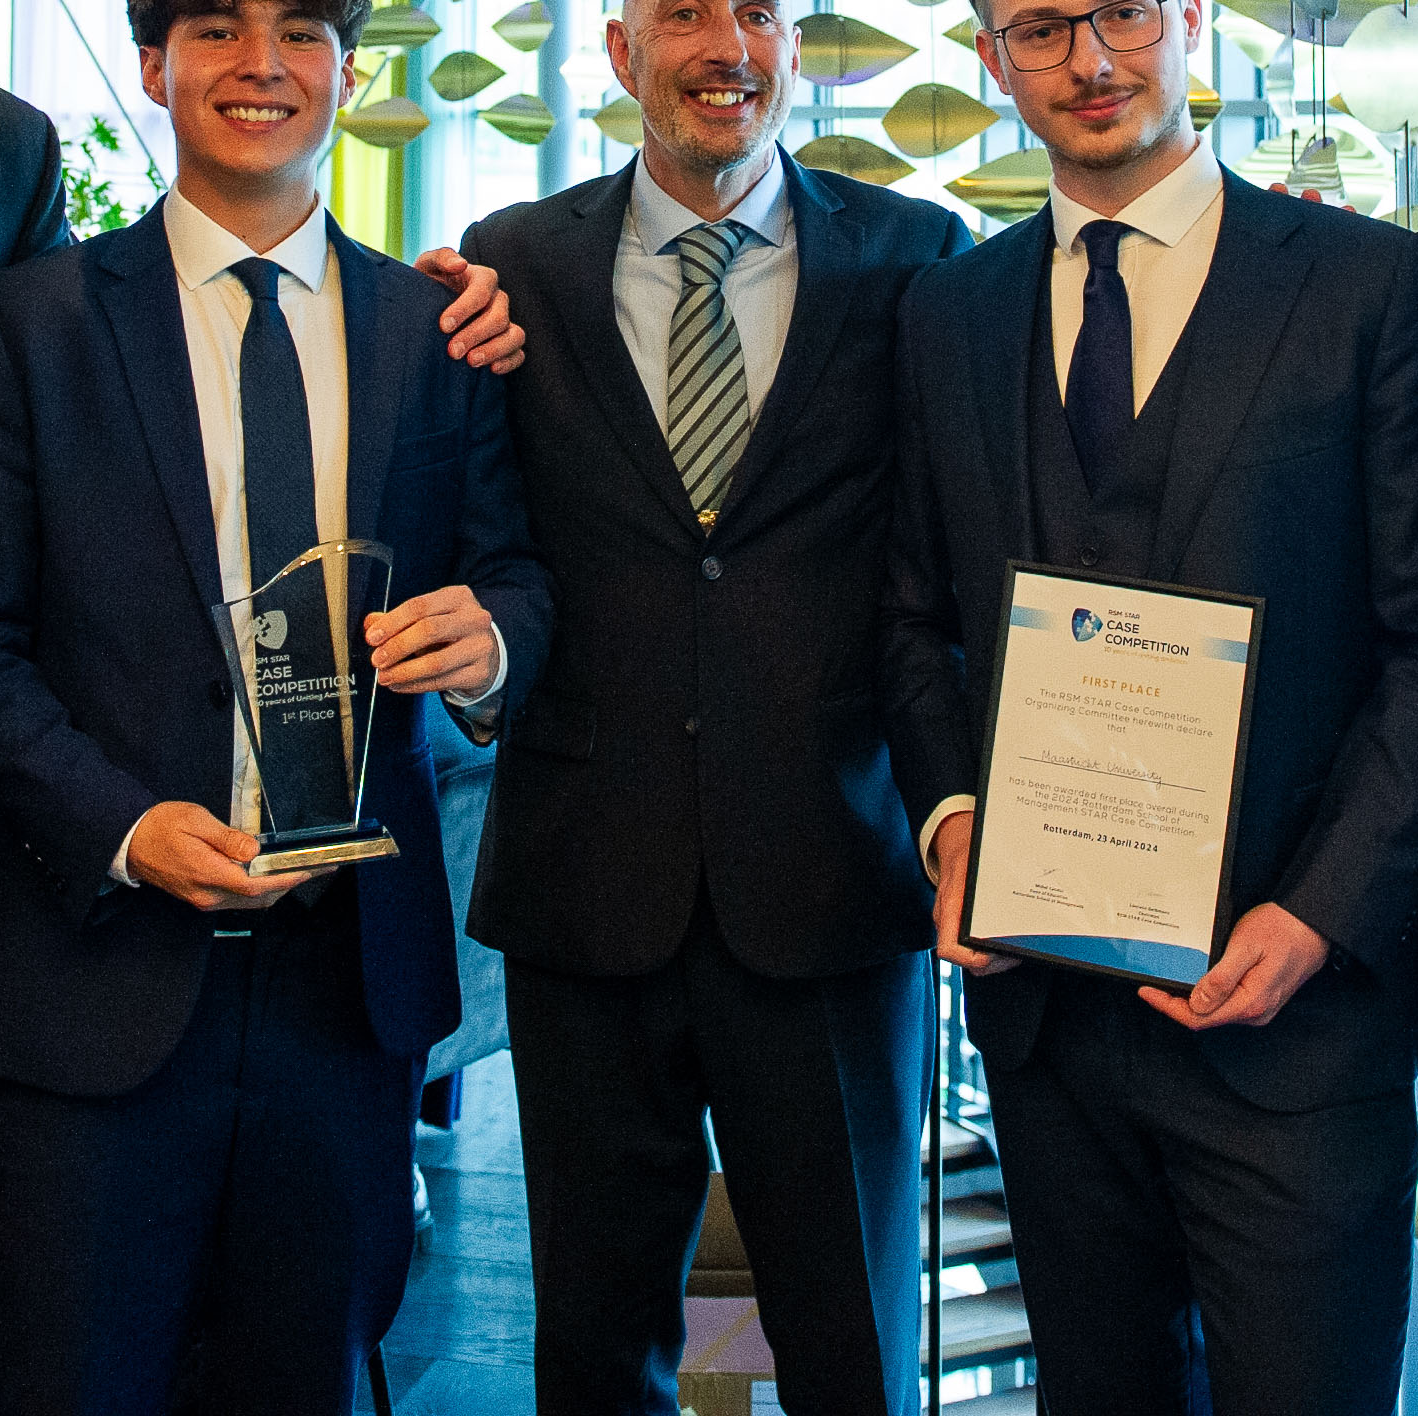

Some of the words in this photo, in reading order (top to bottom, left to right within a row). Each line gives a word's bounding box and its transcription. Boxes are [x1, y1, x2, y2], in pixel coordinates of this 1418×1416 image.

[1106, 620, 1140, 633] CASE
[1105, 633, 1190, 656] COMPETITION
[270, 654, 290, 663] STAR
[1082, 676, 1117, 689] FIRST
[1120, 682, 1161, 697] PLACE
[300, 709, 335, 722] Place
[1025, 697, 1076, 716] Organizing
[1078, 706, 1130, 722] Committee
[1132, 716, 1174, 730] herewith
[1176, 725, 1213, 737] declare
[1040, 688, 1056, 699] The
[1059, 692, 1081, 703] RSM
[1083, 696, 1112, 708] STAR
[1114, 701, 1140, 713] Case
[1142, 706, 1201, 724] Competition
[1107, 724, 1126, 733] that
[1009, 776, 1025, 786] has
[1028, 779, 1051, 790] been
[1053, 785, 1097, 799] awarded
[1099, 793, 1117, 803] first
[1119, 798, 1143, 807] place
[1145, 803, 1177, 815] overall
[1179, 808, 1210, 824] during
[1016, 795, 1078, 814] Management
[1080, 807, 1108, 820] STAR
[1111, 813, 1136, 825] Case
[1035, 790, 1050, 800] the
[1051, 793, 1079, 805] 2024
[1081, 798, 1134, 816] Rotterdam
[1137, 809, 1168, 822] School
[1043, 823, 1094, 842] Rotterdam,
[1109, 836, 1132, 848] April
[1134, 841, 1158, 852] 2024
